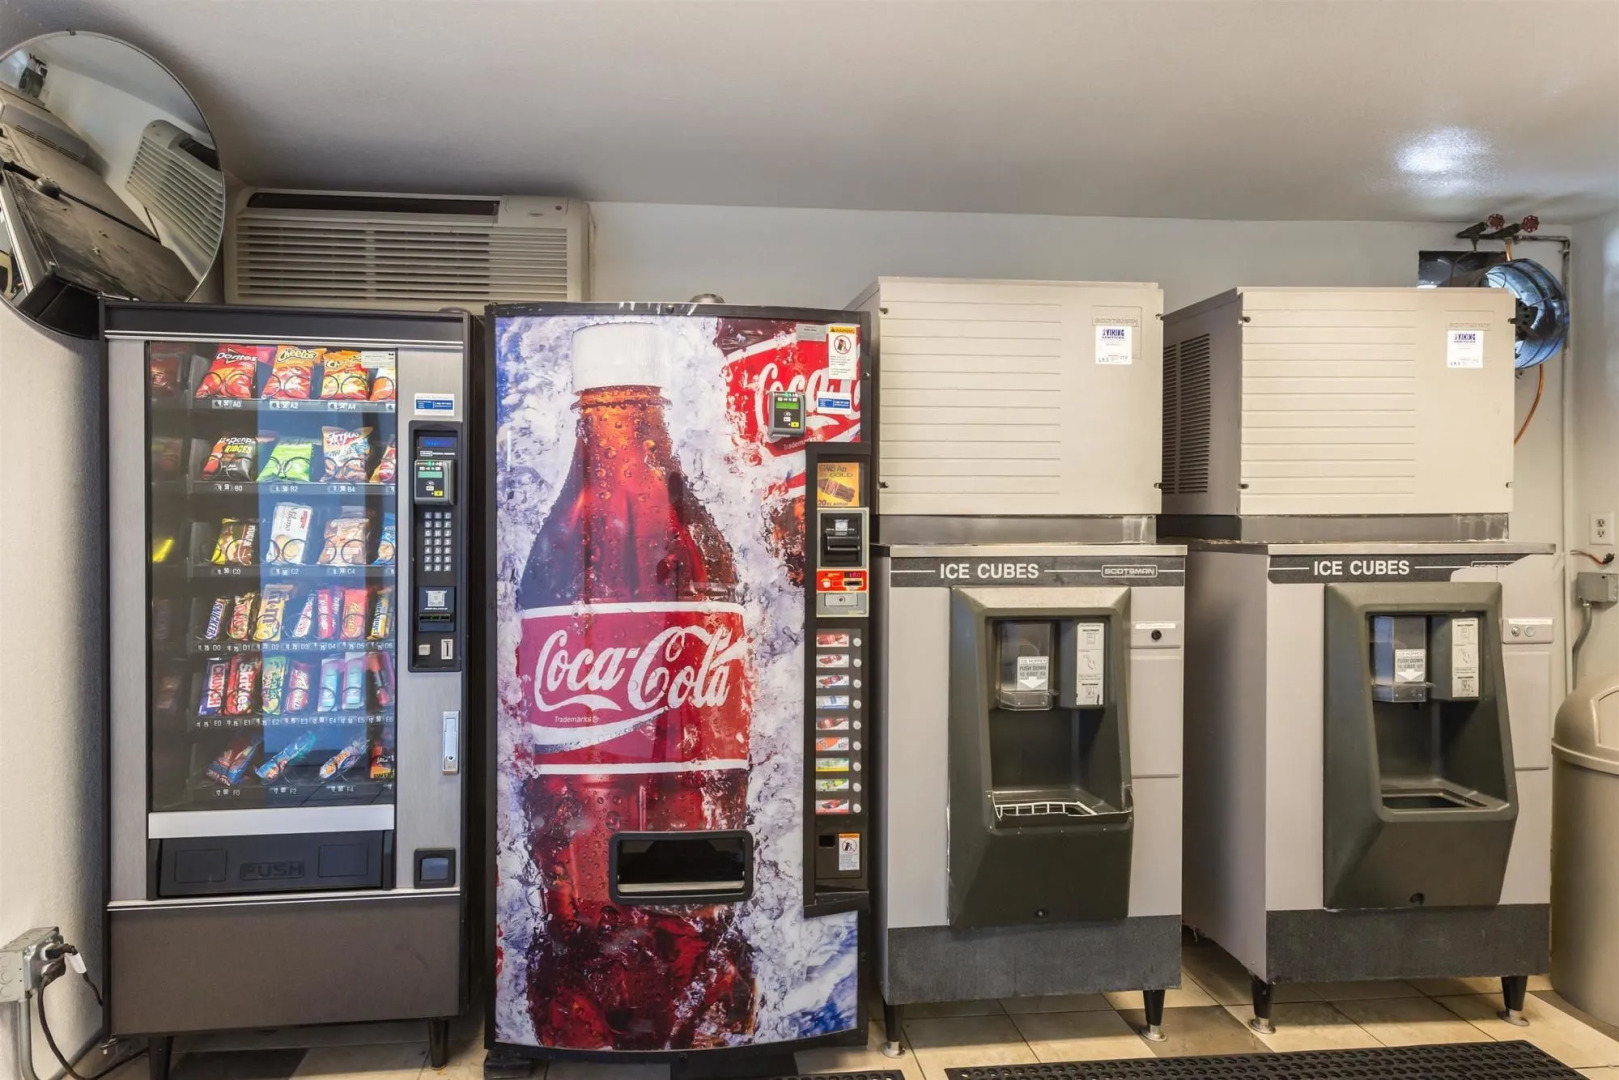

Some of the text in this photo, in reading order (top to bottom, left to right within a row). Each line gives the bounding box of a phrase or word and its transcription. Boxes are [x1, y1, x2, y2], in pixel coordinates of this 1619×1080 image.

[216, 352, 258, 361] Doritos
[277, 347, 317, 362] Cheetos
[286, 506, 298, 532] Milano
[940, 563, 1039, 579] ICE CUBES
[1314, 560, 1410, 575] ICE CUBES
[205, 600, 224, 639] SNICKERS
[534, 624, 751, 712] Coca-Cola
[208, 664, 225, 706] CRUNCH
[237, 663, 254, 711] Skittles
[242, 863, 303, 877] PUSH
